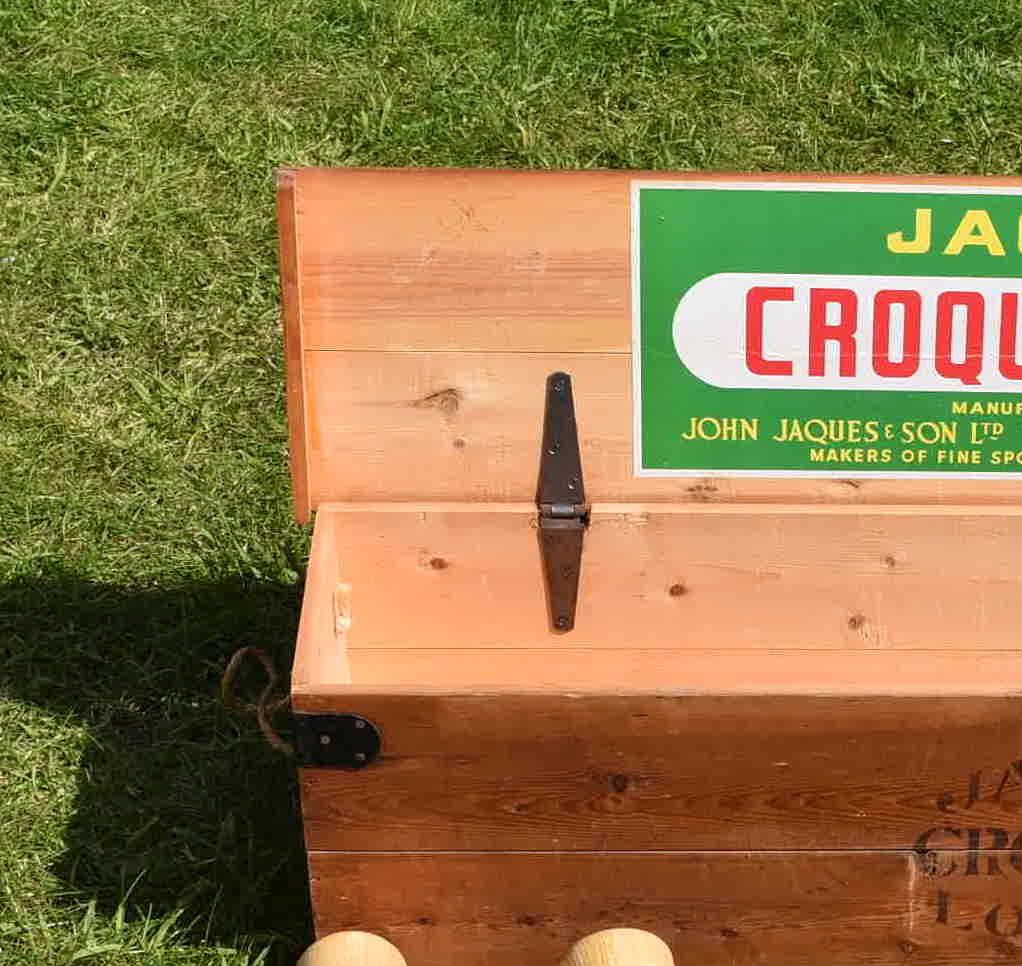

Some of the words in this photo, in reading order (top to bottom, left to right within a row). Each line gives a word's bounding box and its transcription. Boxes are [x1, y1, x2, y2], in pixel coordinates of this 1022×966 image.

[681, 417, 760, 442] JOHN
[773, 418, 879, 446] JAQUES
[901, 421, 958, 445] SON
[809, 448, 893, 463] MAKERS
[901, 449, 928, 464] OF
[937, 450, 982, 465] FINE
